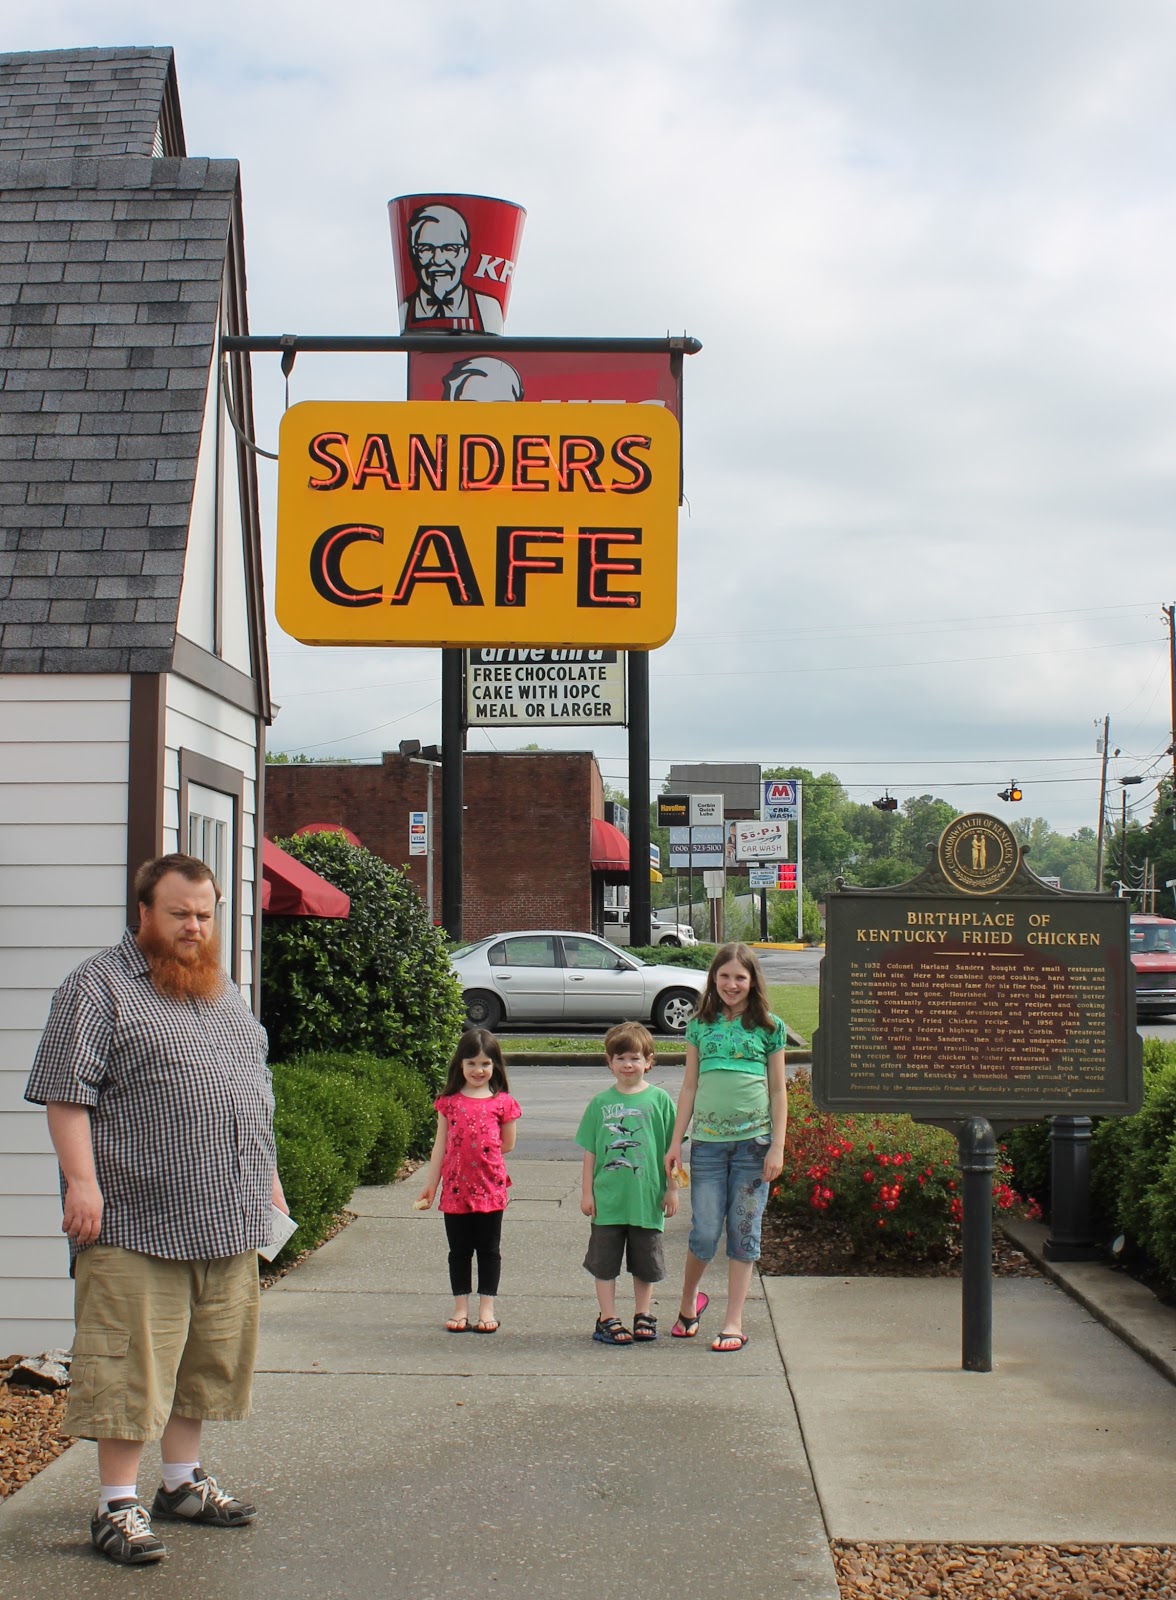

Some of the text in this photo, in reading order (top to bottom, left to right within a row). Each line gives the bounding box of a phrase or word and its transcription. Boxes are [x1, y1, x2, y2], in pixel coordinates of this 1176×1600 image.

[308, 432, 652, 495] SANDERS
[309, 523, 643, 608] CAFE
[473, 666, 607, 682] FREE CHOCOLATE
[472, 685, 513, 700] CAKE
[518, 684, 558, 699] WITH
[476, 702, 612, 718] MEAL OR LARGER
[772, 786, 790, 797] M
[660, 804, 686, 812] Havoline
[692, 844, 722, 852] 523-5100
[944, 818, 1013, 870] COMMONWEALTH OF KENTUCKY
[907, 911, 1050, 927] BIRTHPLACE OF
[856, 930, 1101, 946] KENTUCKY FRIED CHICKEN
[991, 965, 1017, 973] bought
[987, 974, 1006, 982] good
[851, 981, 898, 989] showmanship
[932, 982, 962, 990] regional
[1050, 993, 1078, 1001] patrons
[884, 999, 922, 1007] constantly
[927, 1000, 977, 1008] experimented
[1024, 1001, 1052, 1009] recipes
[1076, 1002, 1105, 1010] cooking
[965, 1009, 1003, 1017] developed
[1027, 1010, 1063, 1018] perfected
[882, 1017, 916, 1025] Kentucky
[1061, 1020, 1080, 1028] plans
[949, 1027, 979, 1035] highway
[1022, 1046, 1045, 1054] selling
[868, 1053, 890, 1061] recipe
[906, 1063, 929, 1071] began
[980, 1064, 1005, 1072] largest
[924, 1072, 957, 1080] Kentucky
